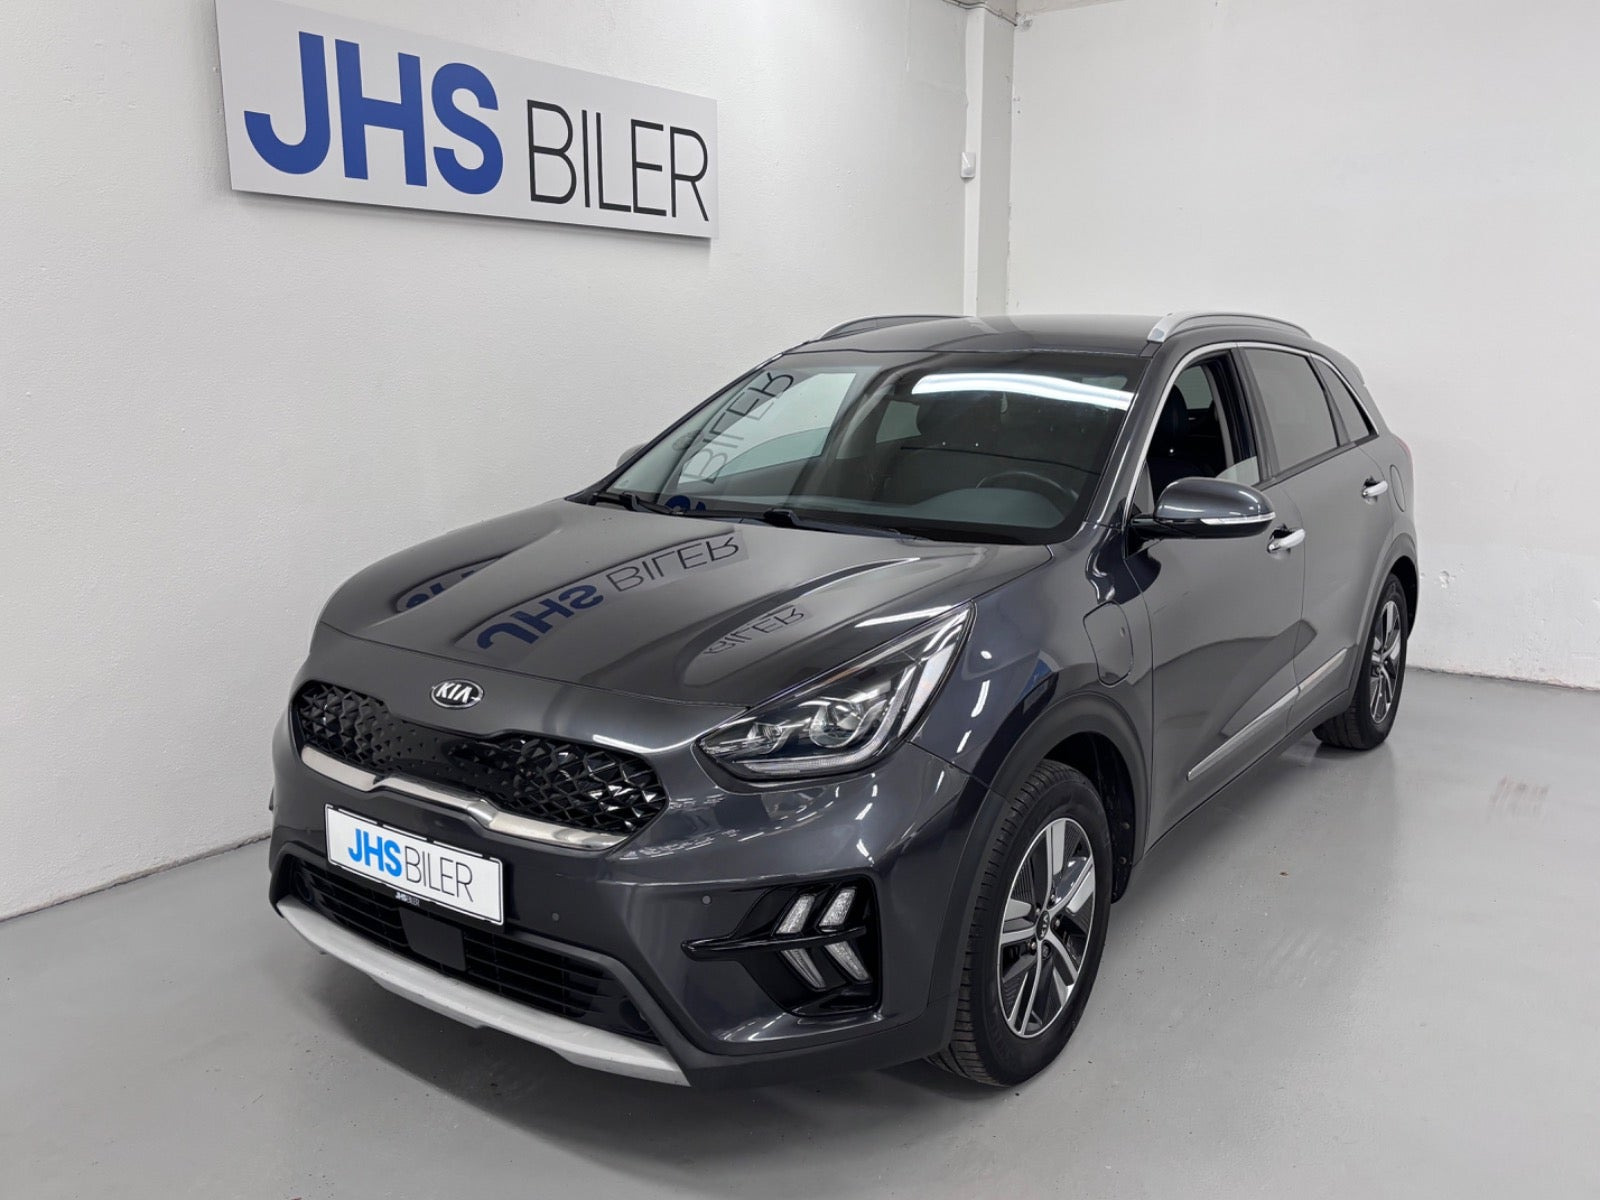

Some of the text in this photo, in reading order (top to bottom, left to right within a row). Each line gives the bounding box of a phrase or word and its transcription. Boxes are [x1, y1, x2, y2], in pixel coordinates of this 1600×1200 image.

[244, 31, 709, 221] JHS BILER
[435, 682, 473, 704] KIA
